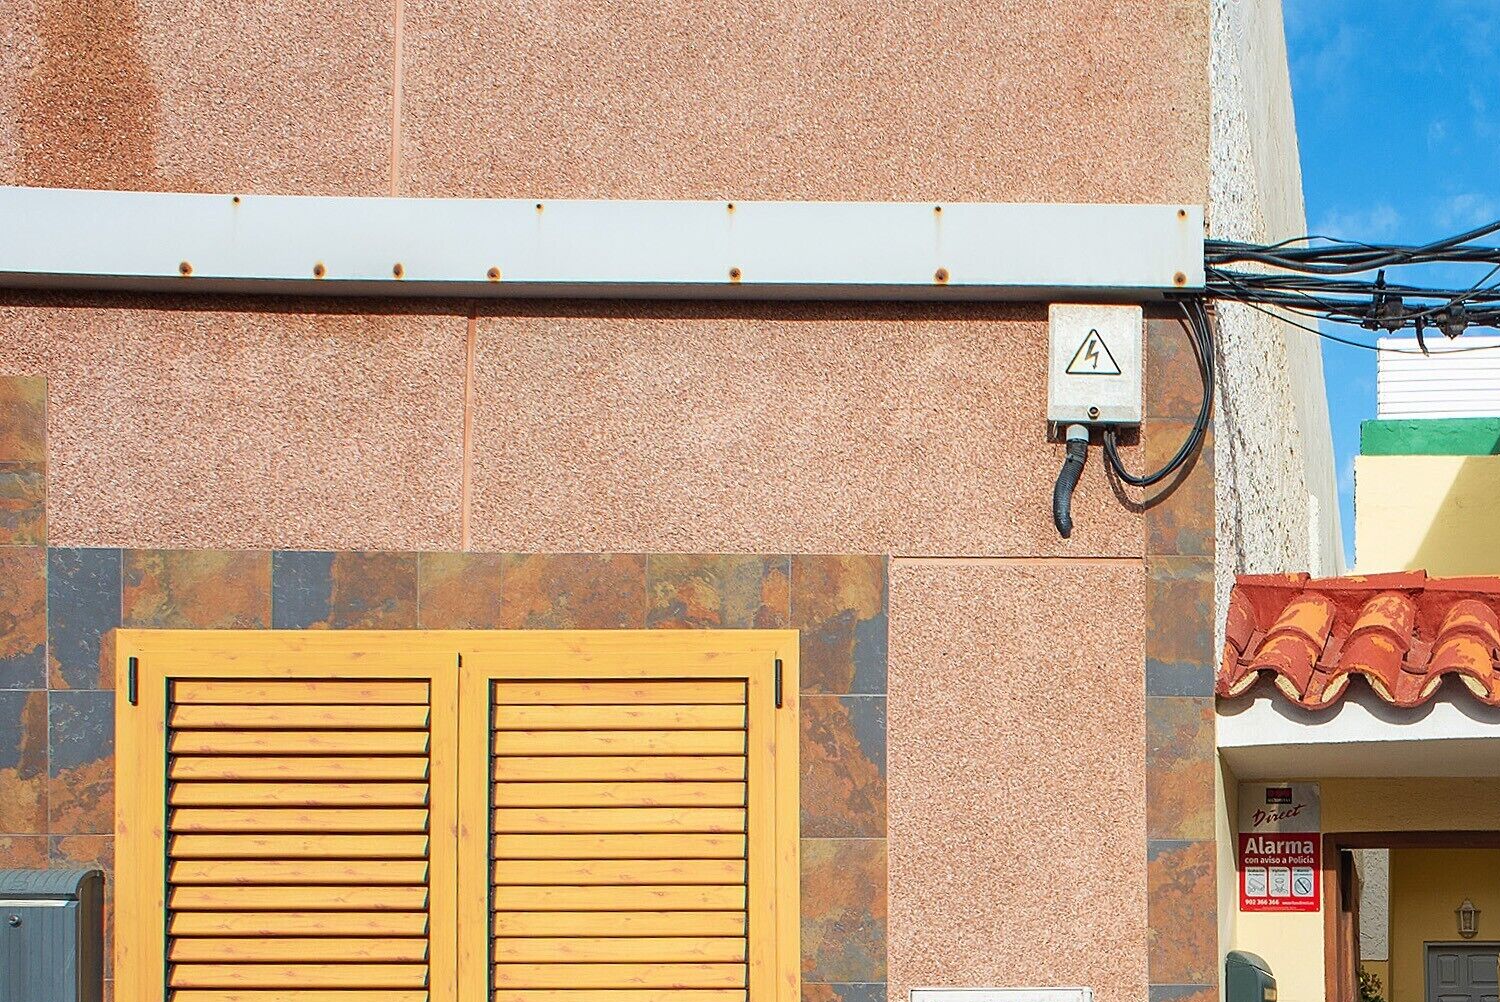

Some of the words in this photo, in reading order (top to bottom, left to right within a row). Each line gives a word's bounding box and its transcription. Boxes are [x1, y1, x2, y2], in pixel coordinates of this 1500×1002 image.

[1252, 804, 1306, 827] Direct
[1245, 837, 1314, 854] Alarma
[1260, 855, 1280, 864] aviso
